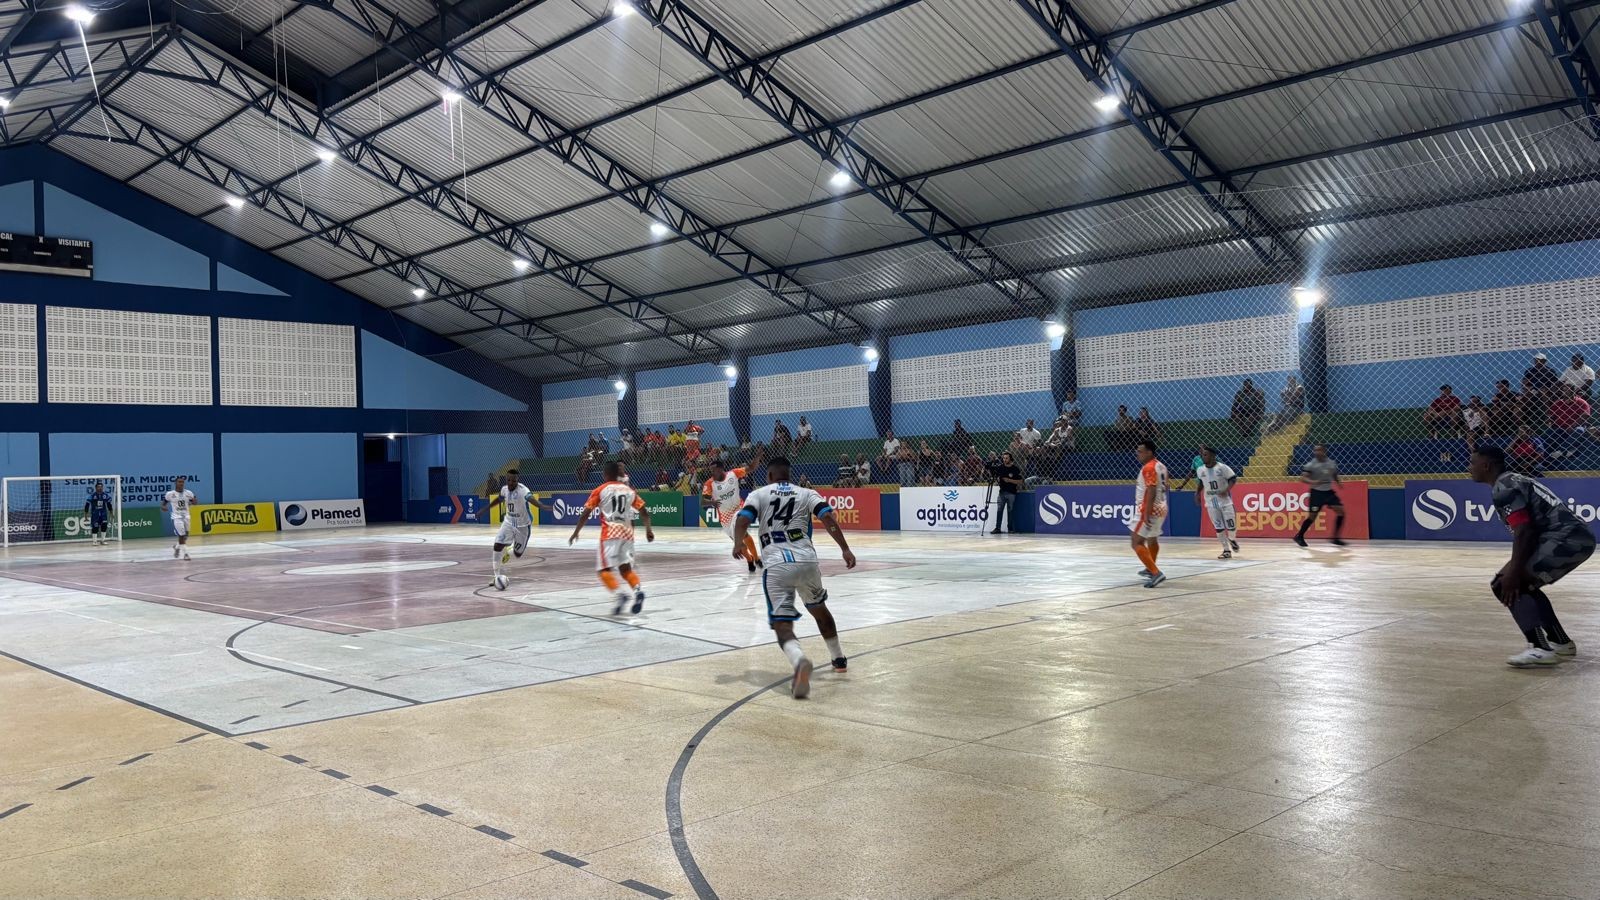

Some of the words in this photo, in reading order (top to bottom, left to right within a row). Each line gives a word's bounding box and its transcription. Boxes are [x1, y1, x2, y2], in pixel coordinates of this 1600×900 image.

[58, 238, 90, 248] VISITANTE
[1209, 481, 1218, 490] 10
[121, 493, 167, 503] SPORTE
[611, 494, 626, 514] 10
[823, 495, 855, 510] OBO
[1243, 492, 1312, 512] GLOBO
[311, 507, 362, 520] Plamed
[566, 504, 601, 519] tvsegip
[767, 497, 796, 527] 14
[916, 503, 989, 526] agitação
[1072, 501, 1136, 526] tvserg
